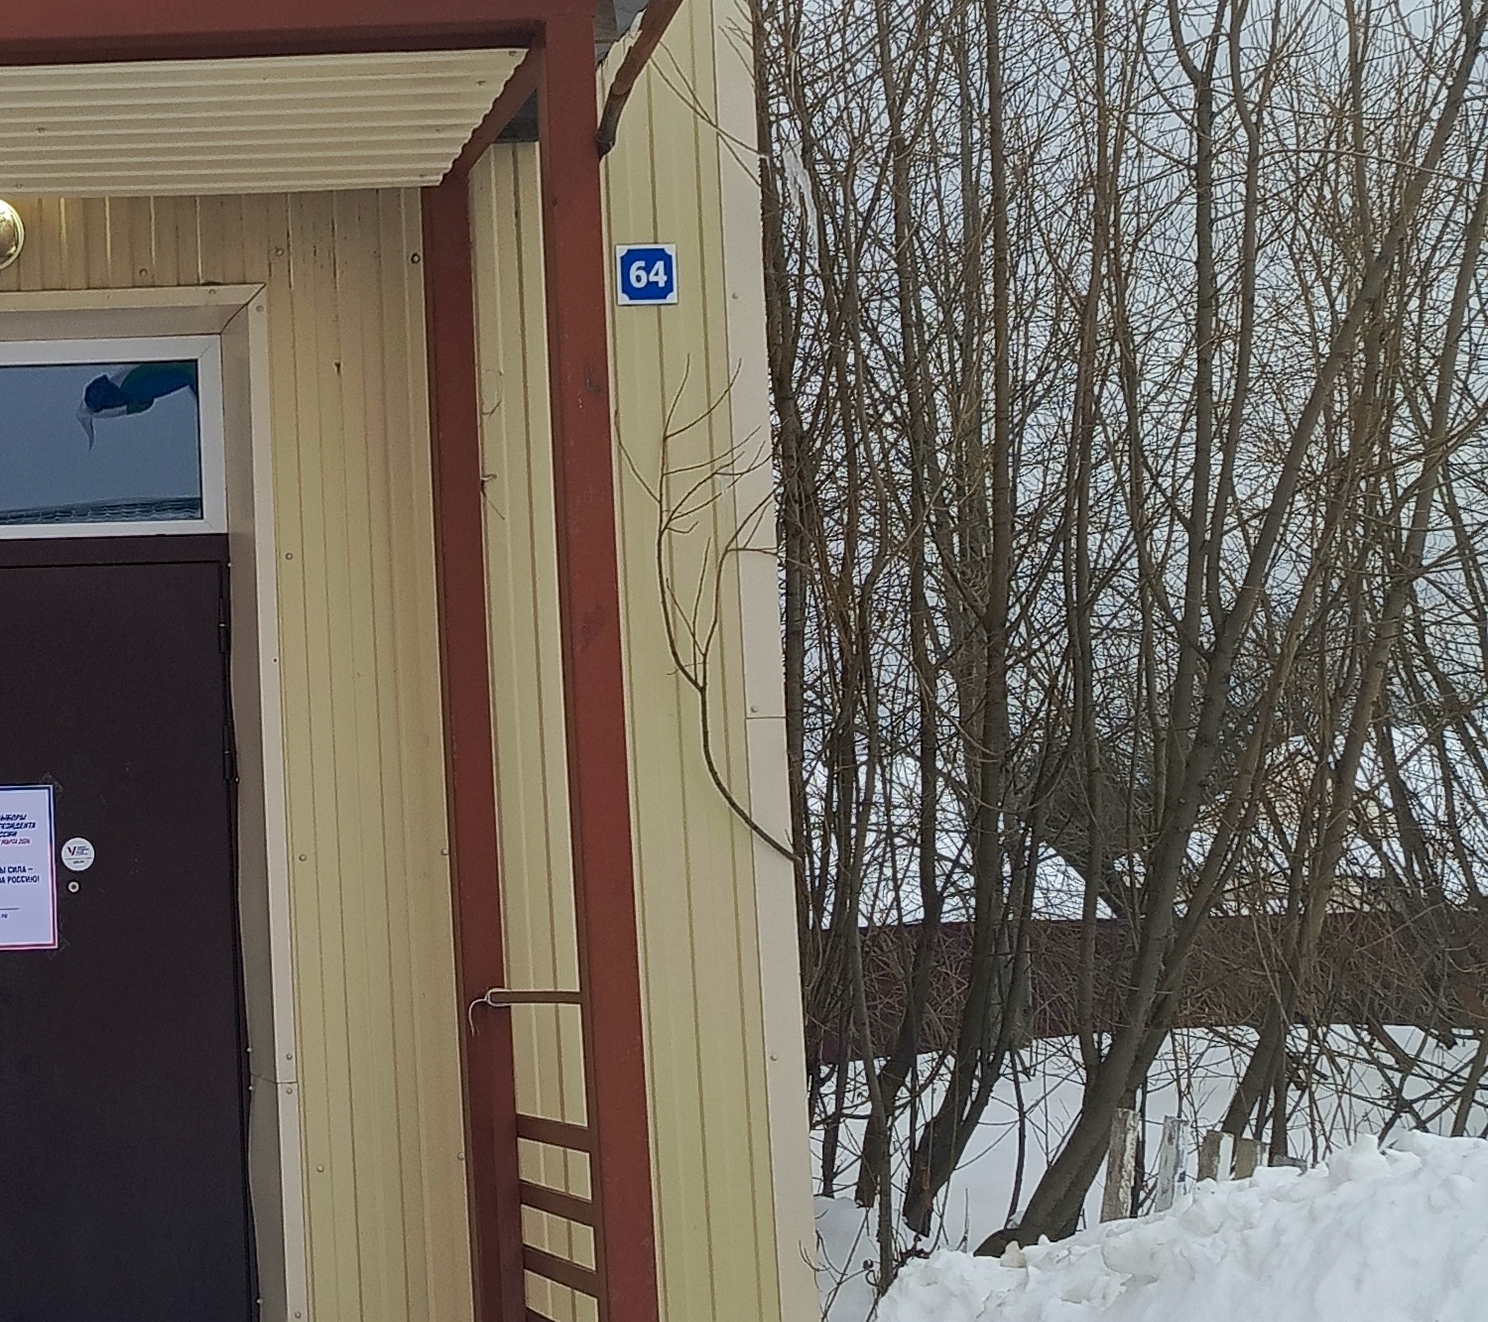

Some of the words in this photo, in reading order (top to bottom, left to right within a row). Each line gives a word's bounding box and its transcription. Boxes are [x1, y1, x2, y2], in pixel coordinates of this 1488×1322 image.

[629, 260, 668, 289] 64
[7, 865, 27, 874] СИЛА
[7, 874, 40, 884] РОССИЮ!
